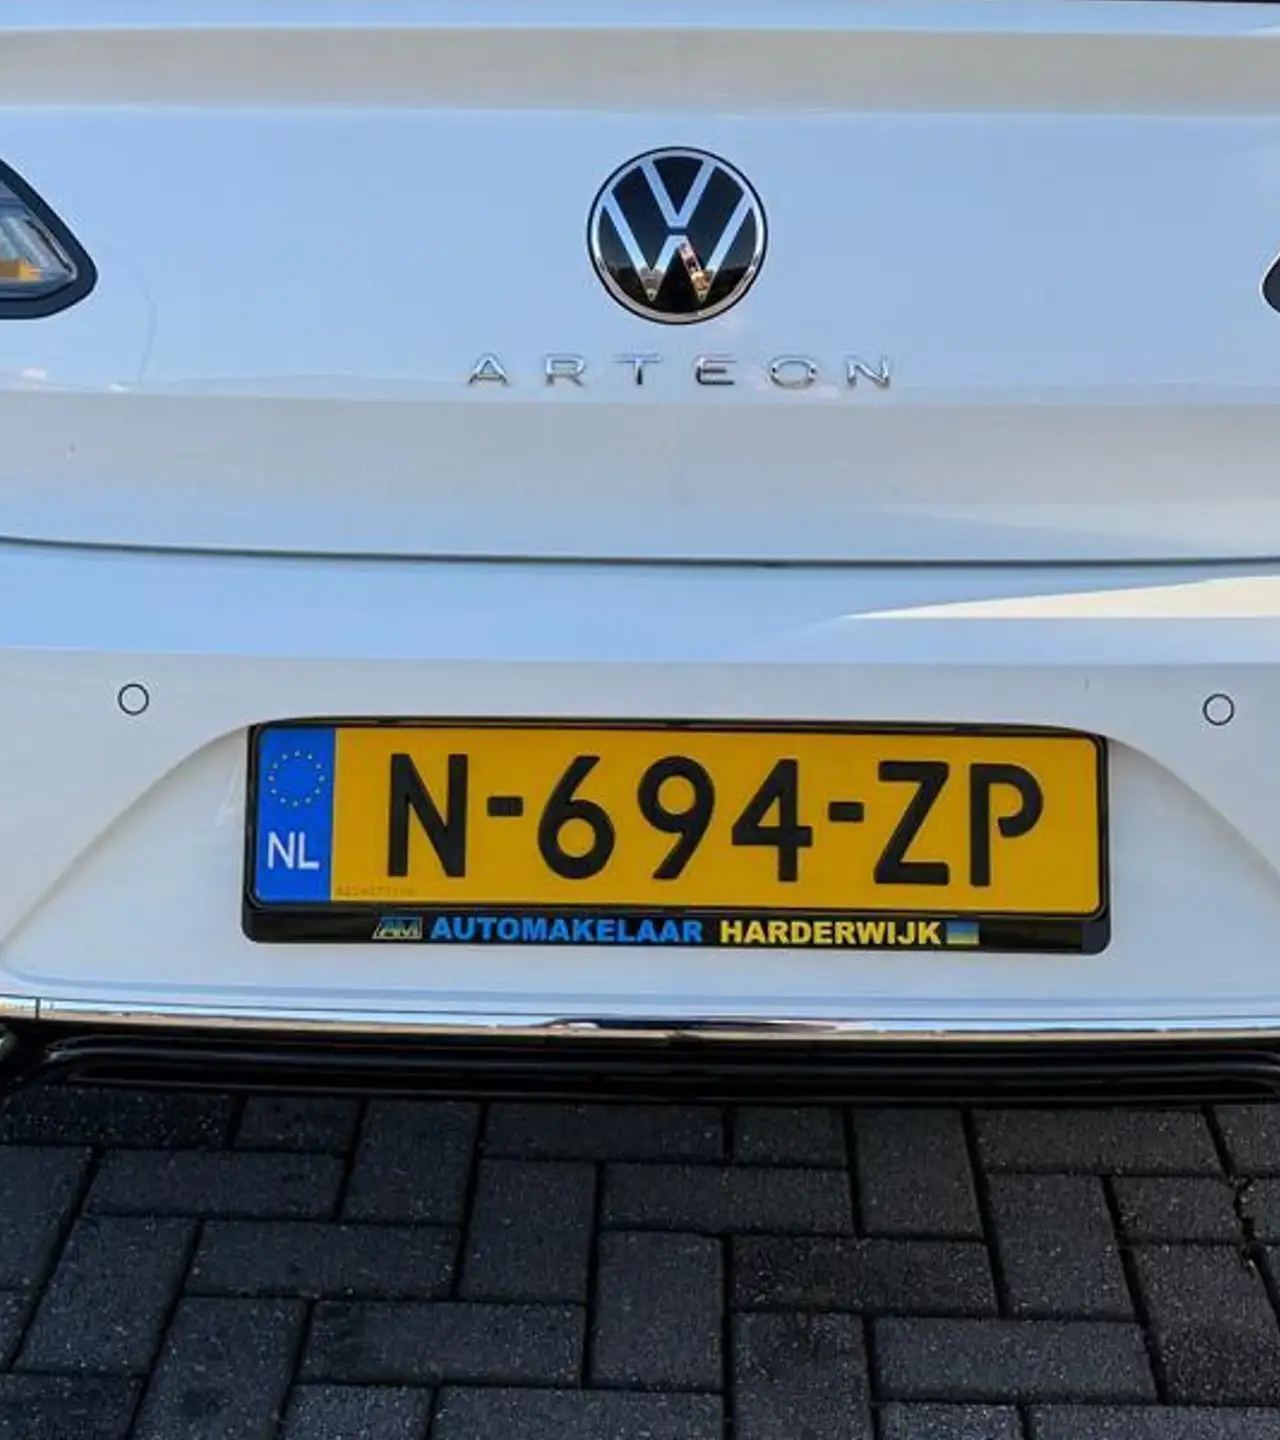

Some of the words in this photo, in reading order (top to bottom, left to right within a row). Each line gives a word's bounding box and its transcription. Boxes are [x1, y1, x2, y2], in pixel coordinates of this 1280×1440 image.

[467, 353, 891, 389] ARTEON
[387, 753, 1044, 888] N-694-ZP
[267, 831, 320, 870] NL
[430, 916, 703, 943] AUTOMAKELAAR
[720, 920, 941, 945] HARDERWIJK
